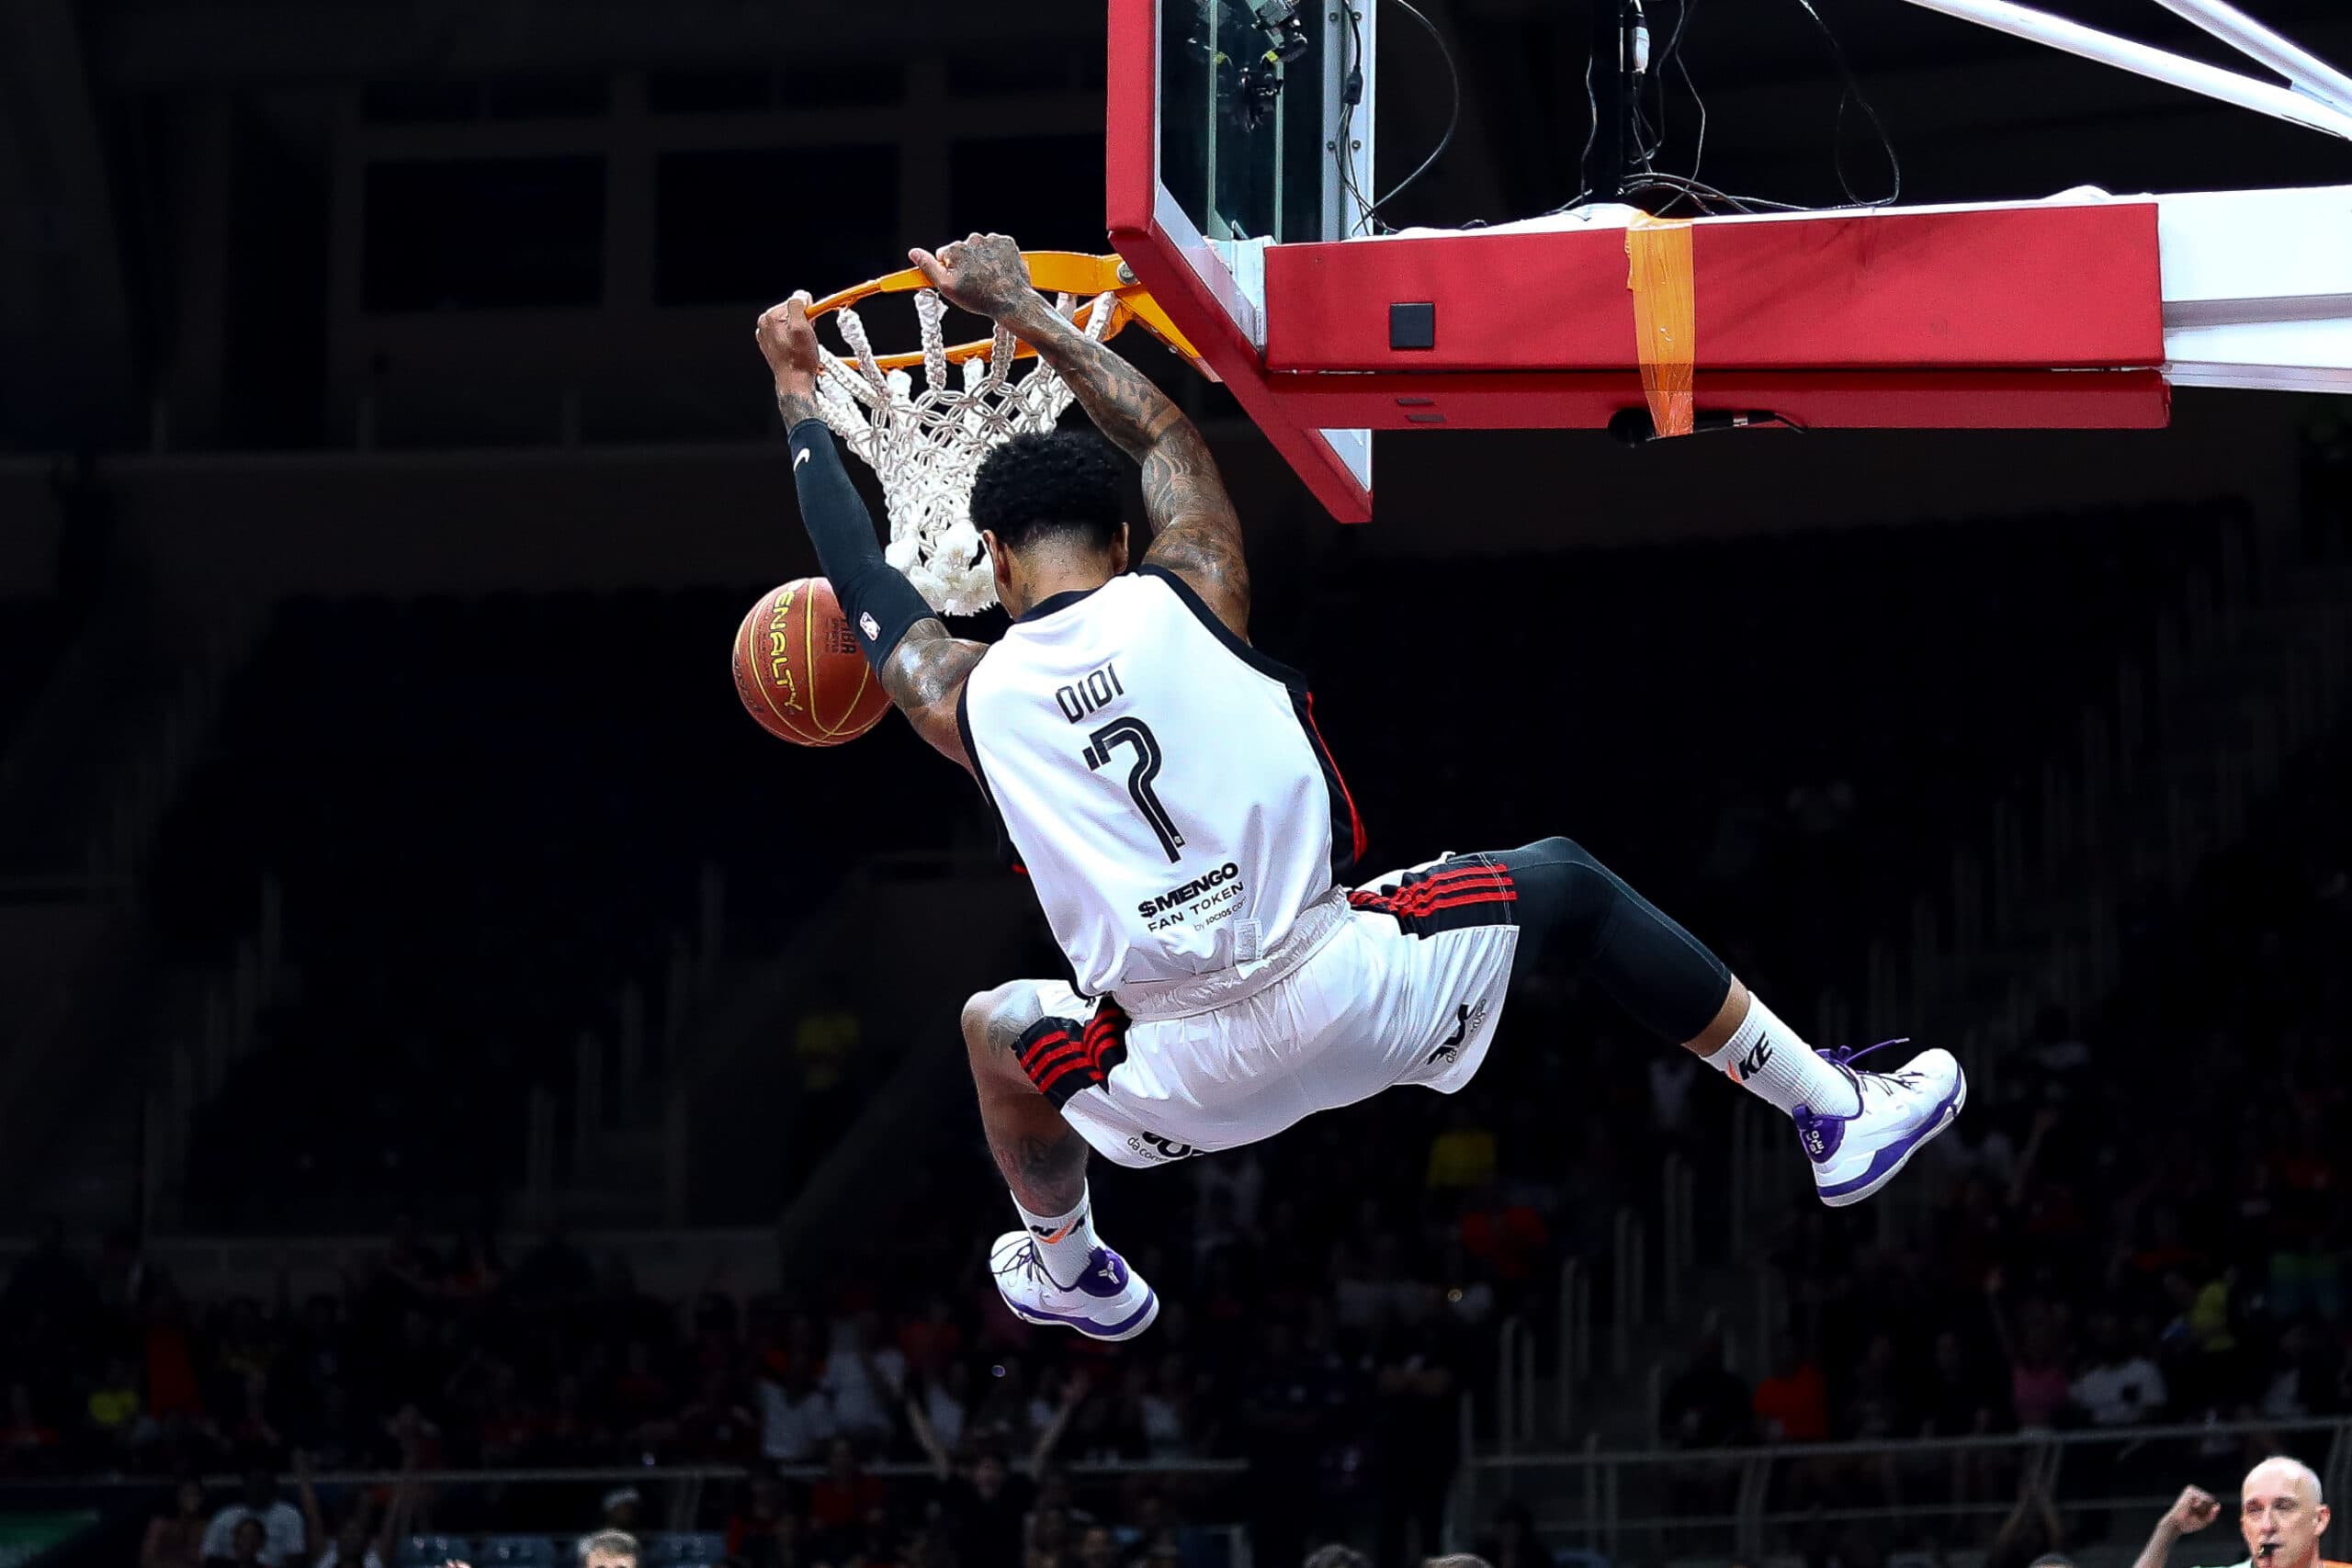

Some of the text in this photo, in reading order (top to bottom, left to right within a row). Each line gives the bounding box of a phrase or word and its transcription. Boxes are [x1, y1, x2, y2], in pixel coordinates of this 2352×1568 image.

[770, 580, 803, 711] ENALTY
[1056, 662, 1125, 724] DIDI
[1081, 716, 1185, 863] 7
[1138, 862, 1238, 918] $MENGO
[1148, 881, 1244, 932] FAN TOKEN
